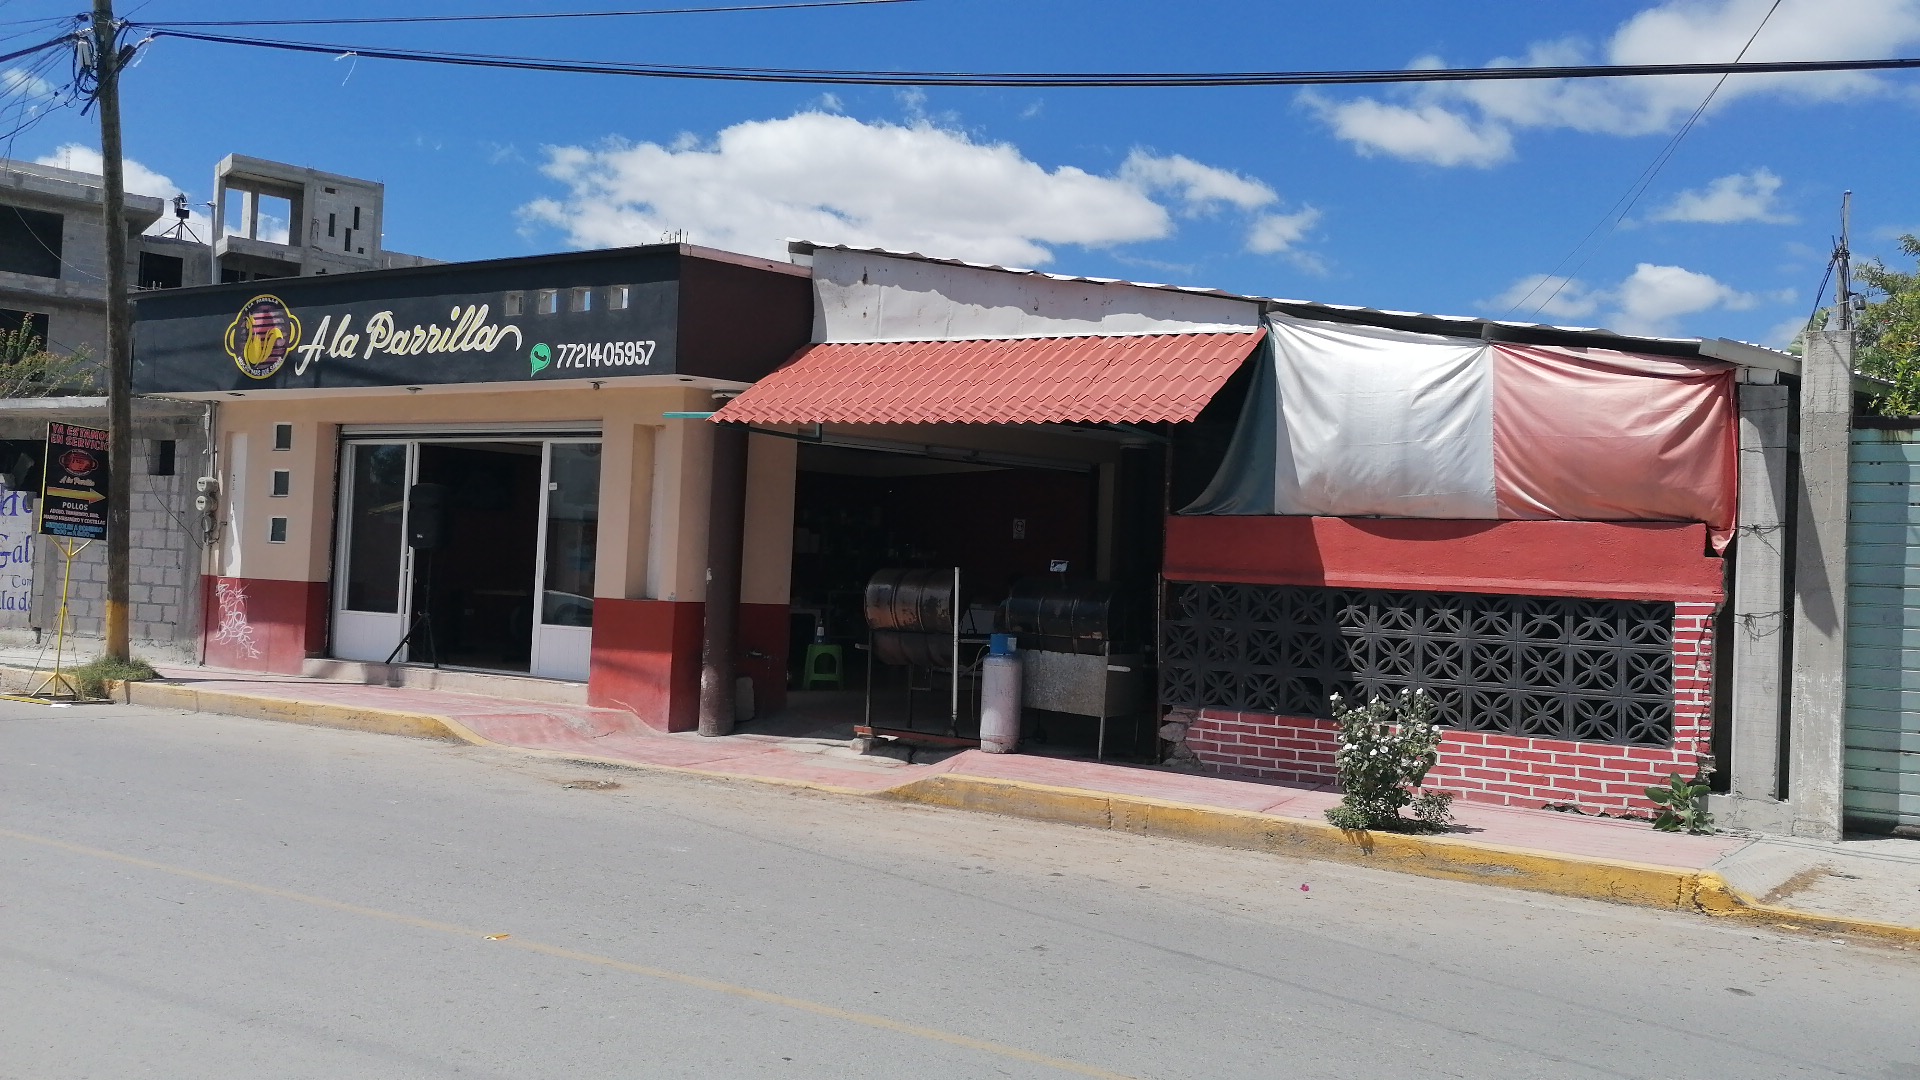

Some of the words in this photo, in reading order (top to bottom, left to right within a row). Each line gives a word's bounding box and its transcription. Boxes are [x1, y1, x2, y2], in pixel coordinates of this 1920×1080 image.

[295, 315, 331, 376] A
[326, 313, 360, 359] la
[363, 303, 523, 360] Parrilla
[555, 340, 656, 369] 7721405957
[52, 422, 64, 434] YA
[50, 433, 64, 445] EN
[62, 502, 88, 511] POLLOS
